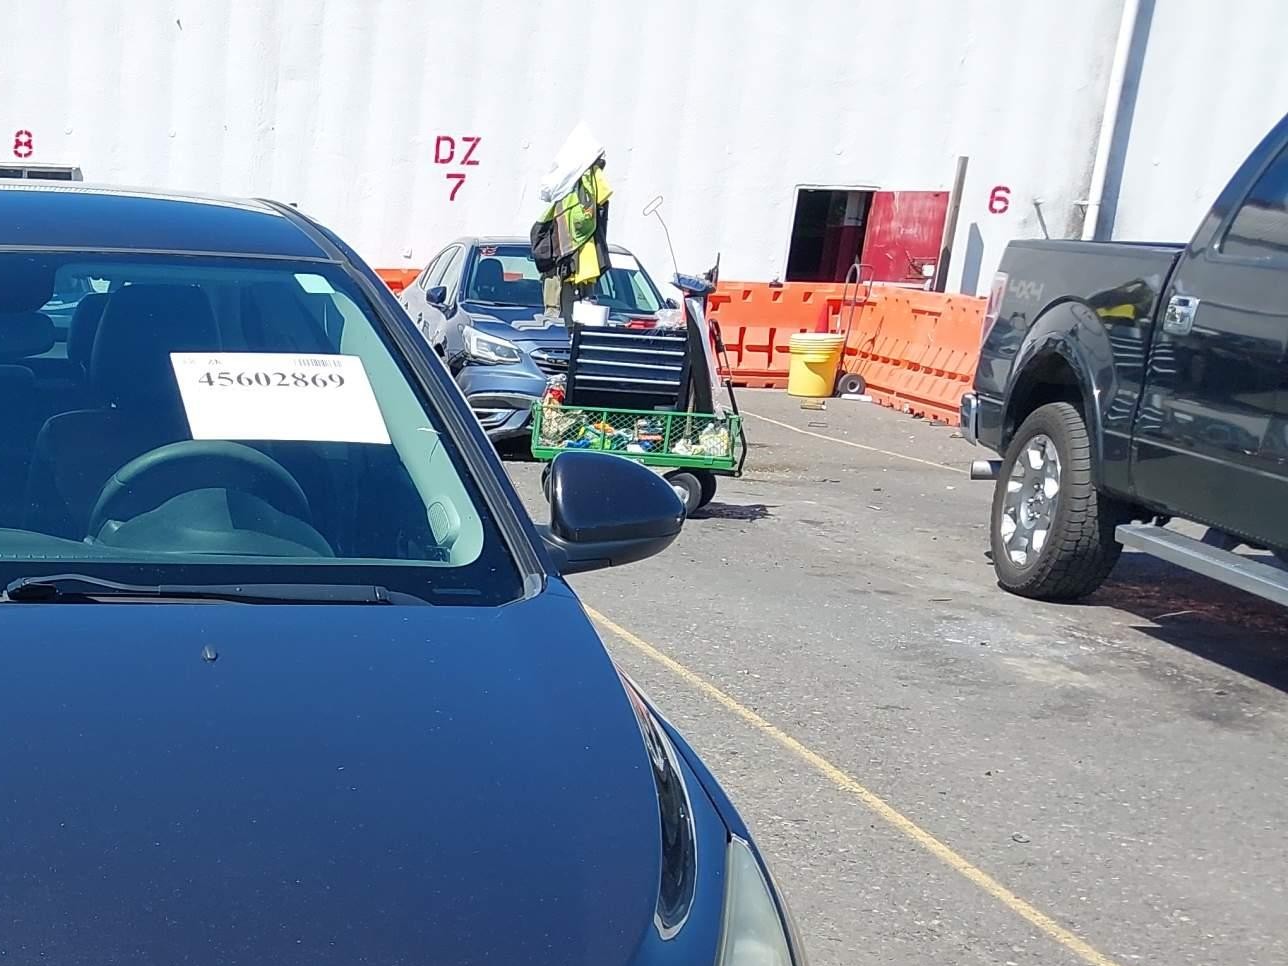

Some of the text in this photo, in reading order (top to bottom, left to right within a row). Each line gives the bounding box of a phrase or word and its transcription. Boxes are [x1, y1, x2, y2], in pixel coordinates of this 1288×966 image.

[13, 129, 33, 158] 8
[434, 135, 482, 165] DZ
[446, 173, 466, 201] 7
[988, 183, 1012, 214] 6
[198, 371, 346, 389] 45602869
